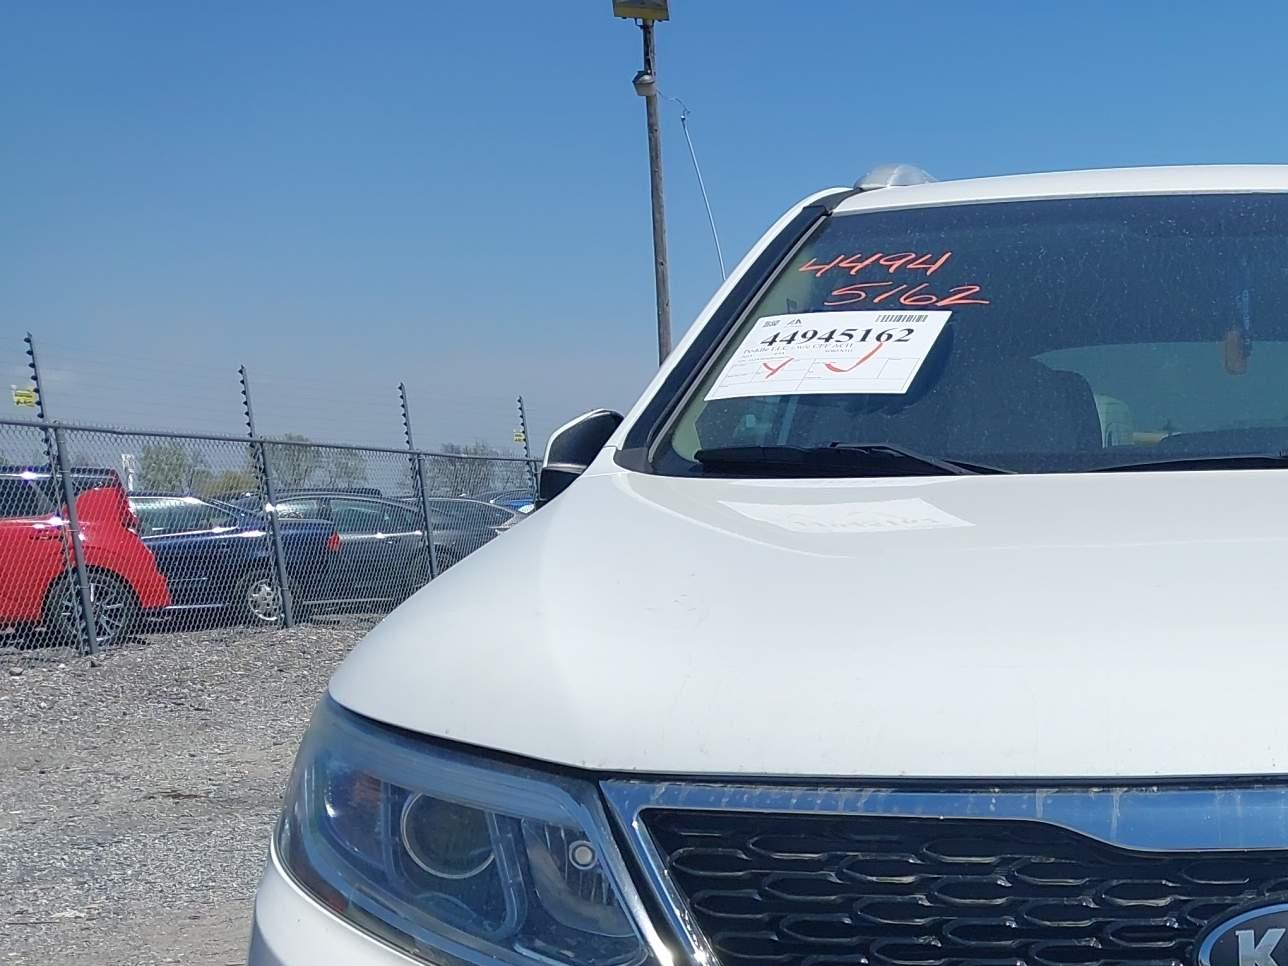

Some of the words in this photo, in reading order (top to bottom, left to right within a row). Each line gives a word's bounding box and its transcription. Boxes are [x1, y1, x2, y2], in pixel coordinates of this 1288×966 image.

[799, 251, 954, 278] 4494
[823, 281, 991, 307] 5162
[760, 327, 915, 347] 44945162
